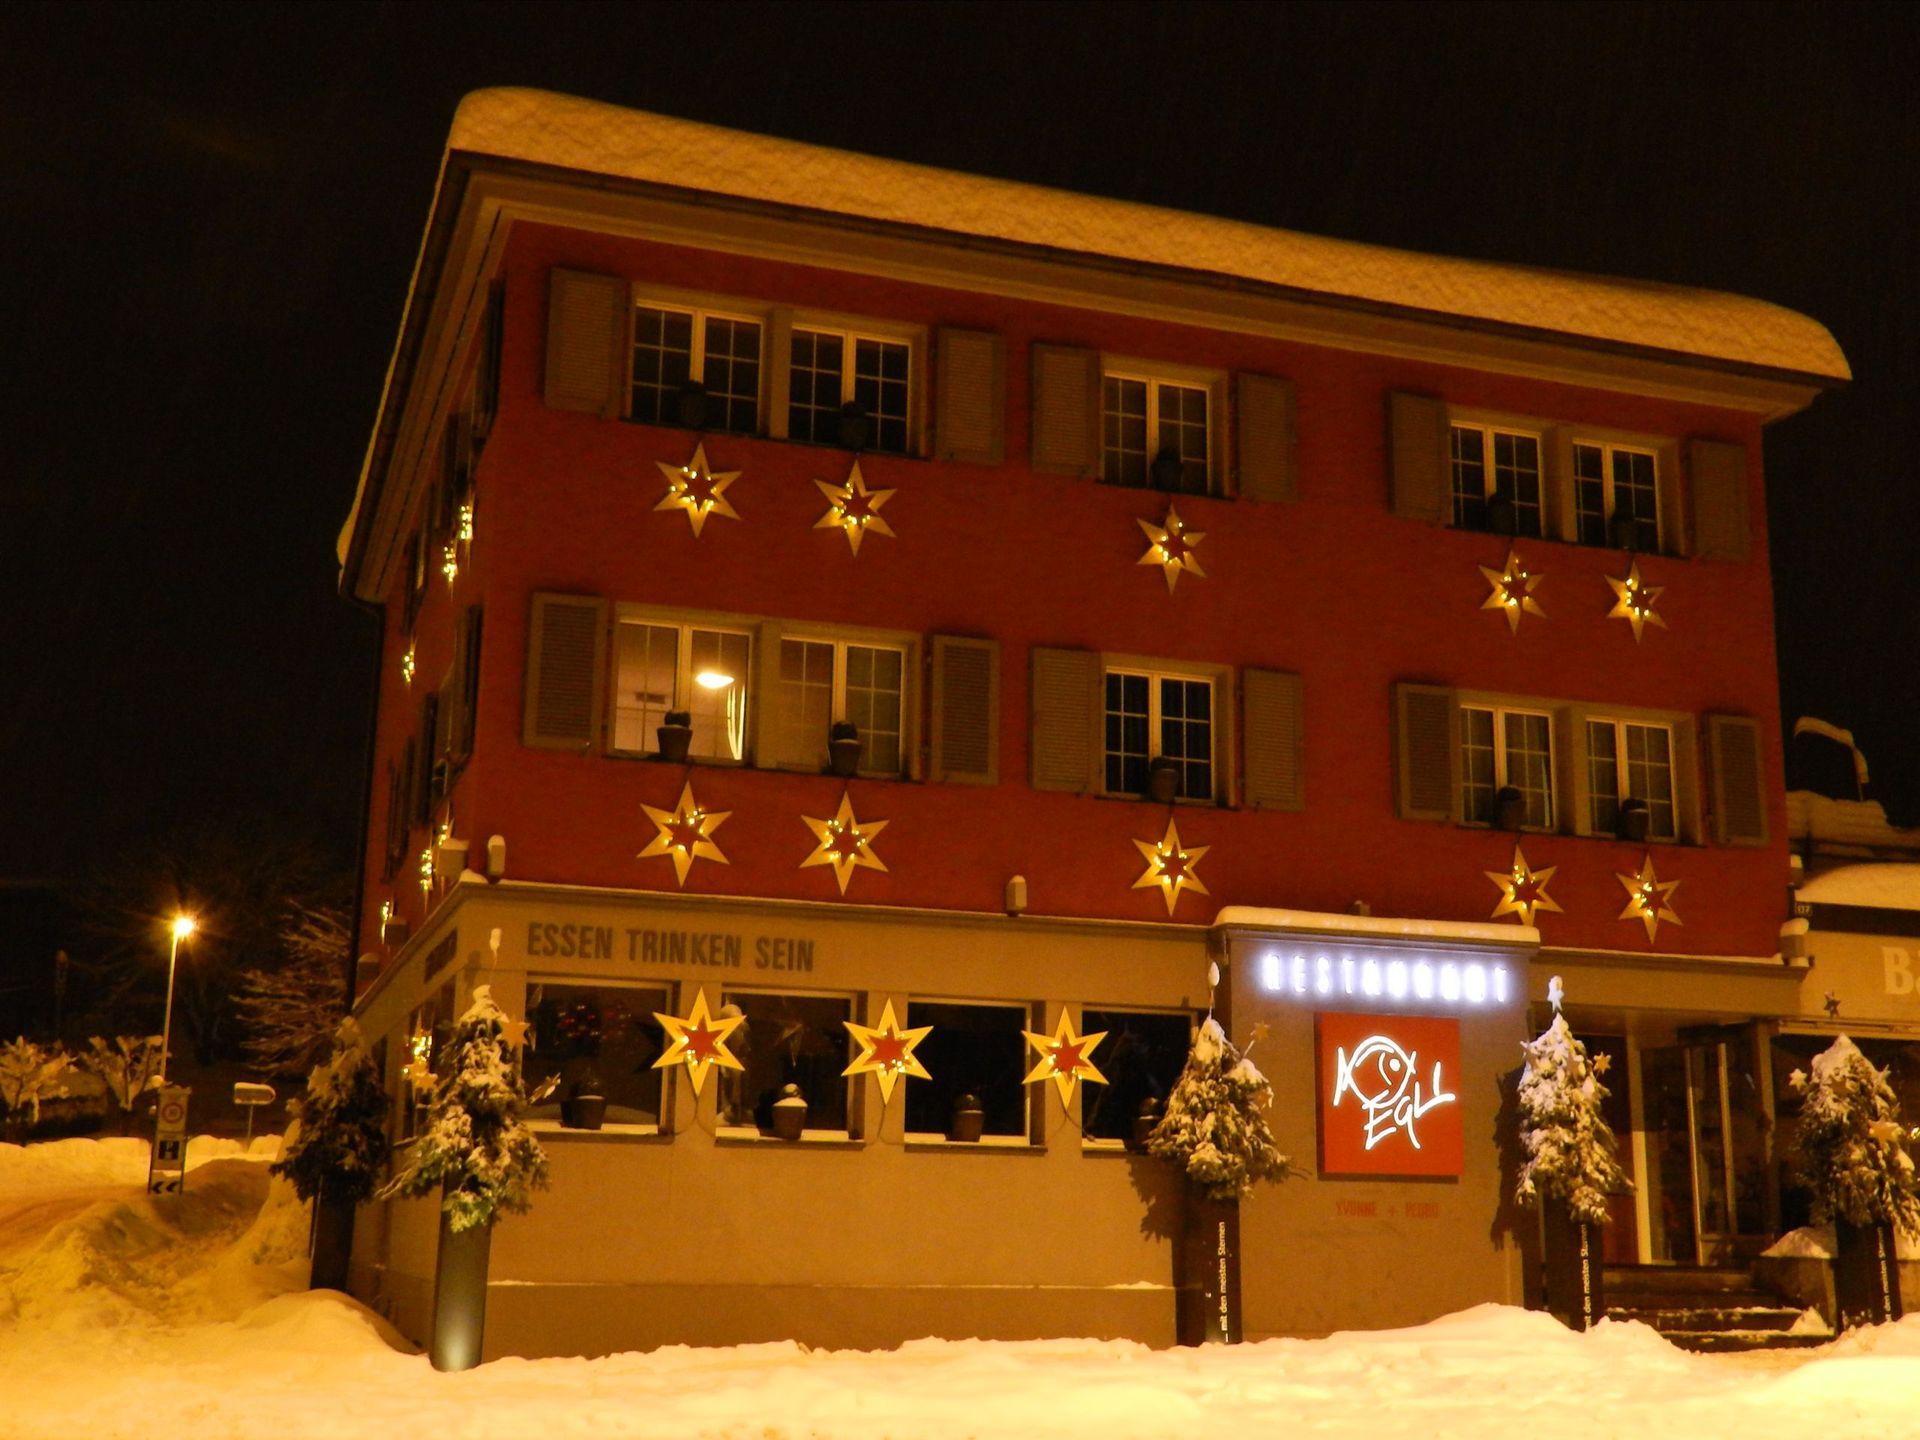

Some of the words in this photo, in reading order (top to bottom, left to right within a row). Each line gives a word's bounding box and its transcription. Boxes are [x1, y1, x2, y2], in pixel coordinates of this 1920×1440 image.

[527, 921, 613, 959] ESSEN
[625, 928, 742, 967] TRINKEN
[755, 936, 815, 972] SEIN
[1882, 946, 1920, 995] B
[1219, 1258, 1227, 1293] meisten
[1582, 1259, 1590, 1294] meisten
